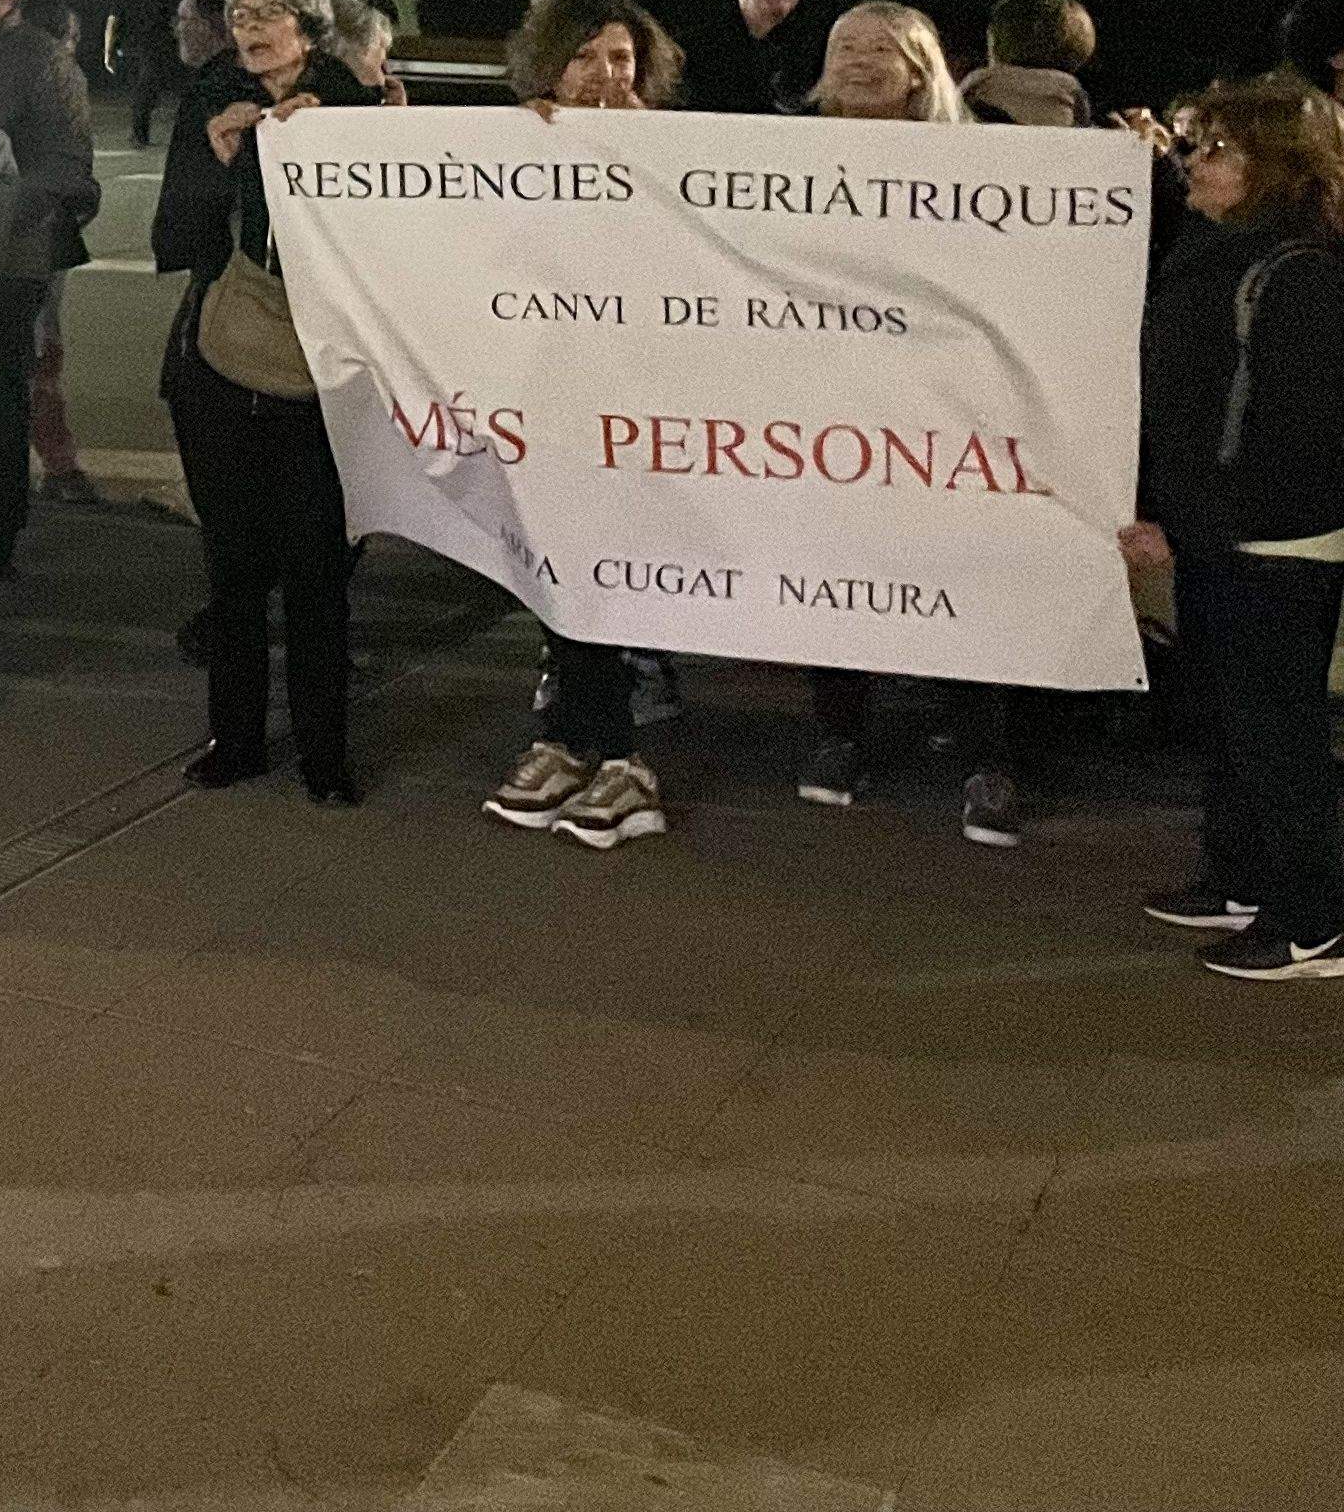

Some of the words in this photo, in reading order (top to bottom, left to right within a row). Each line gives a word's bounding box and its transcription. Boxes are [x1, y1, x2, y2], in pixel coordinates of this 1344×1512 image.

[280, 151, 635, 204] RESIDÈNCIES
[679, 165, 1136, 234] GERIÀTRIQUES
[491, 291, 626, 326] CANVI
[663, 295, 720, 328] DE
[746, 288, 908, 336] RÀTIOS
[391, 390, 527, 465] MÉS
[599, 413, 1055, 497] PERSONAL
[593, 557, 744, 601] CUGAT
[777, 574, 958, 619] NATURA
